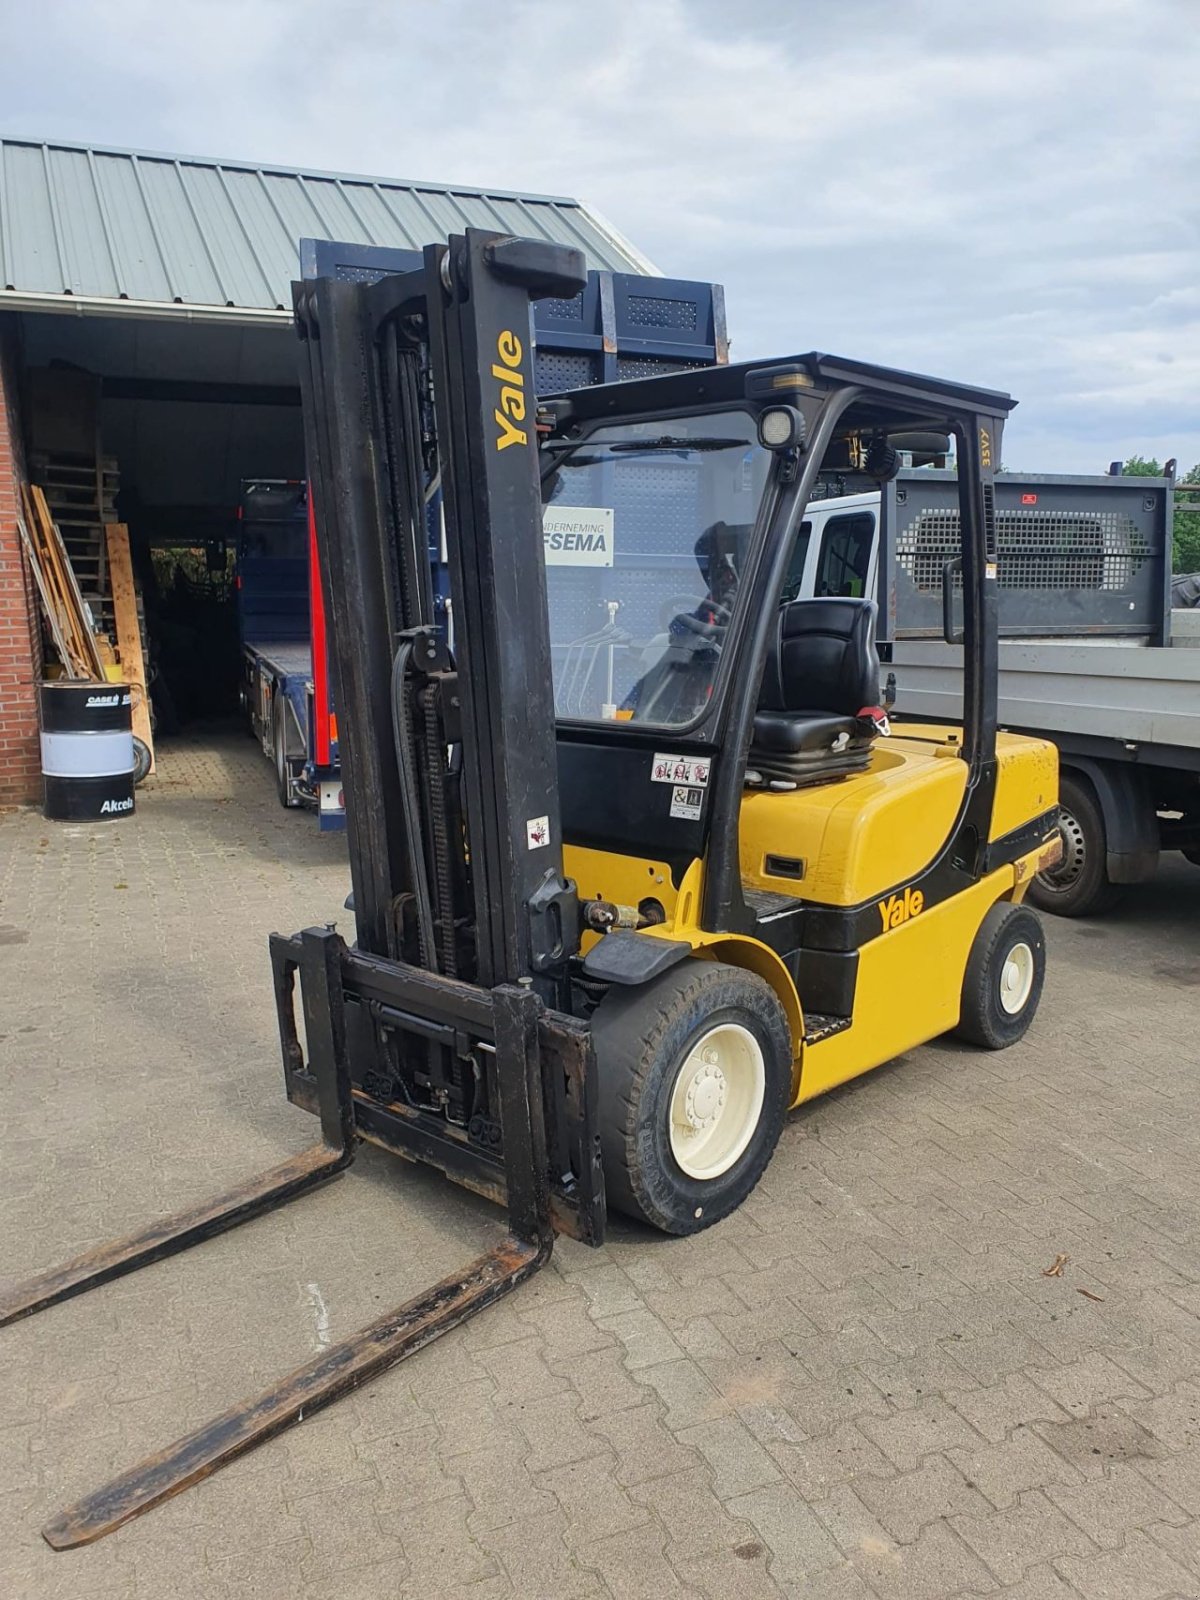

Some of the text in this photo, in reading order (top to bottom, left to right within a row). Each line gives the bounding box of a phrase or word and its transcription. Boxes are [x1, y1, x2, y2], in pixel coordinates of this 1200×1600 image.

[492, 330, 528, 451] Yale
[981, 428, 991, 467] 35VY
[878, 887, 924, 933] Yale
